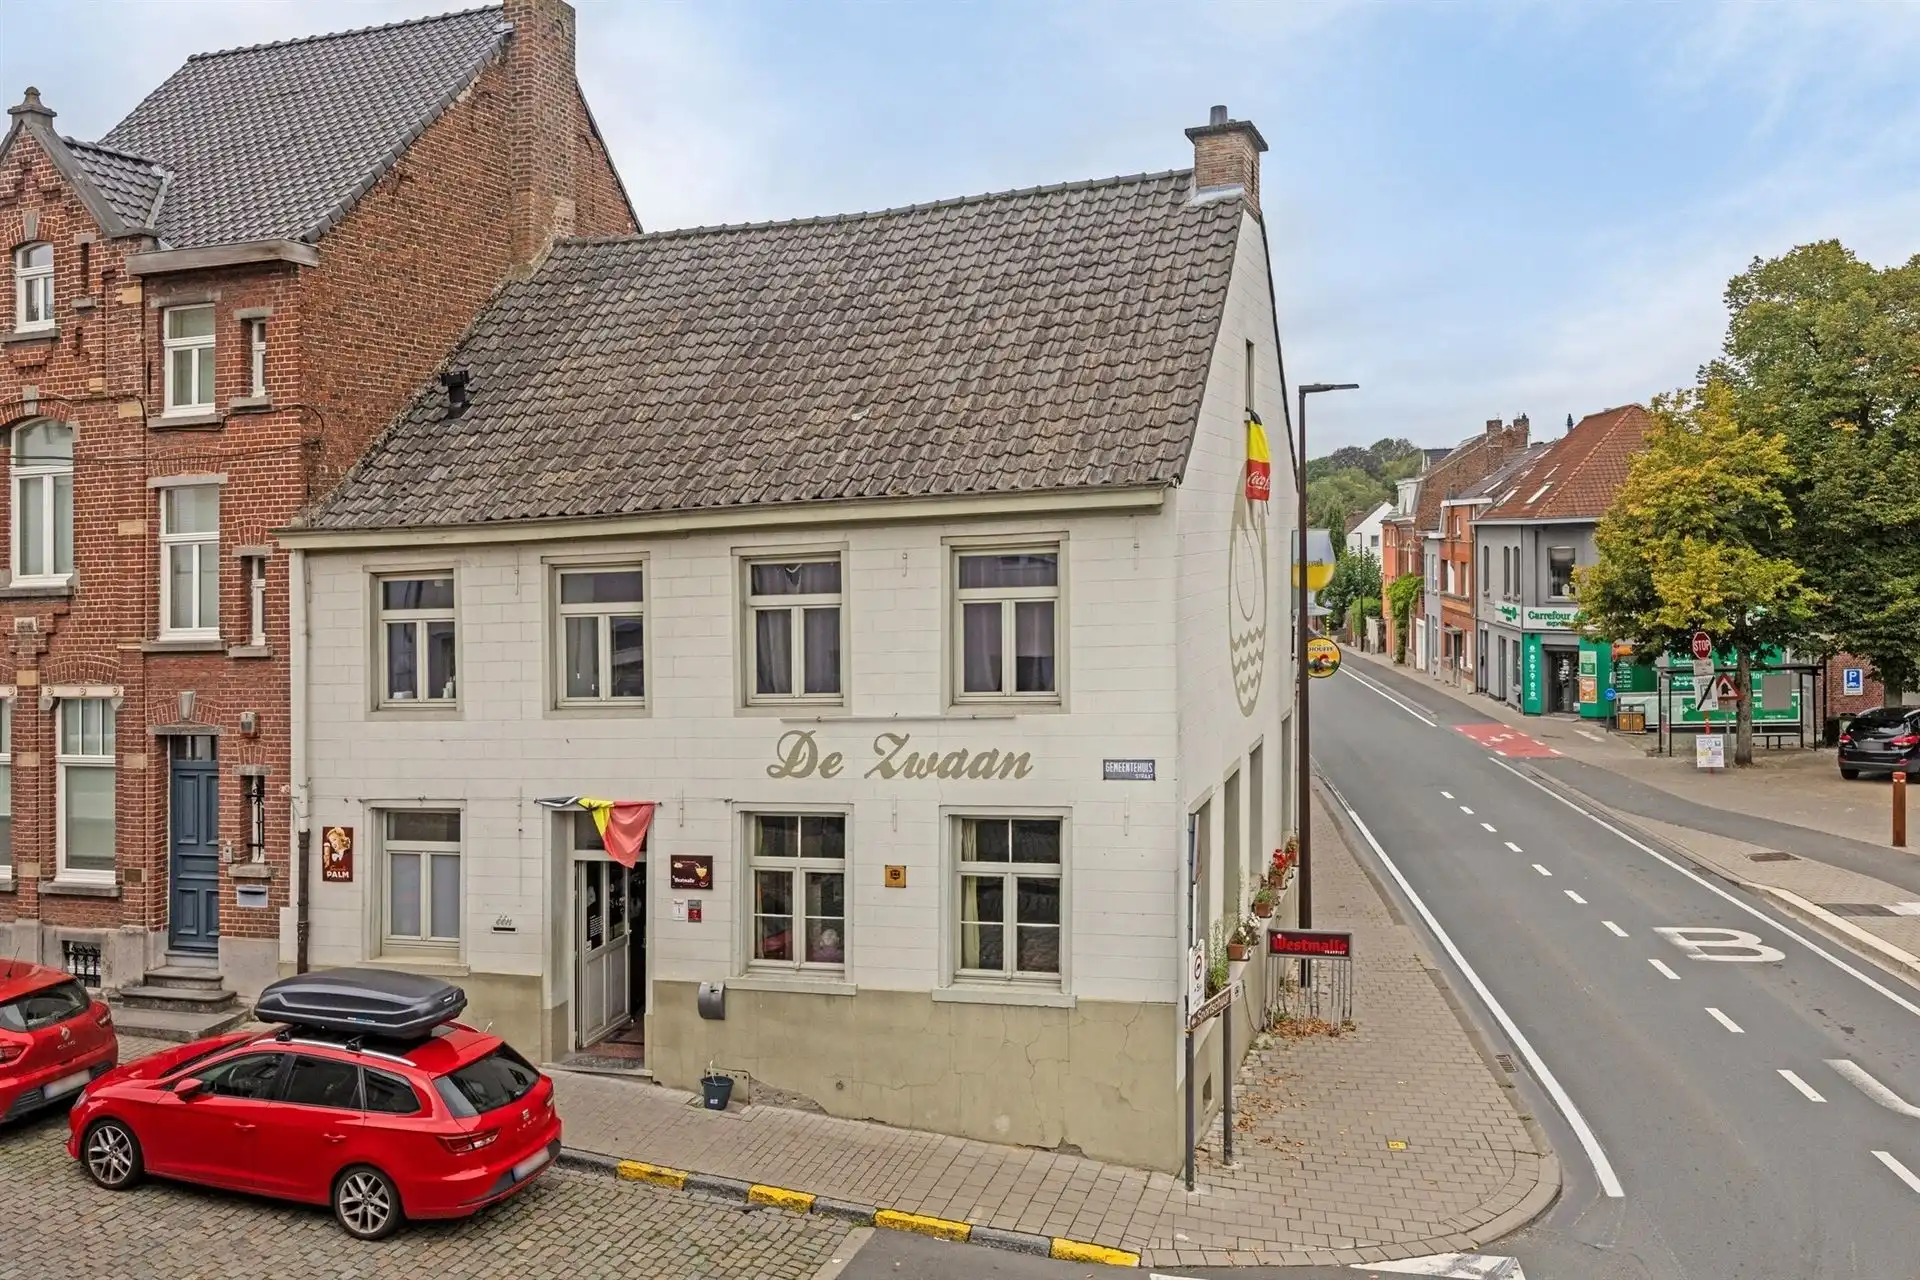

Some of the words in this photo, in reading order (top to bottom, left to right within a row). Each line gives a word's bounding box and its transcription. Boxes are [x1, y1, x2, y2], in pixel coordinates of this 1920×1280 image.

[1528, 611, 1571, 620] Carrefour
[1694, 640, 1710, 651] STOP
[1849, 671, 1857, 681] P
[766, 729, 844, 779] De
[864, 732, 1033, 779] Zwaan
